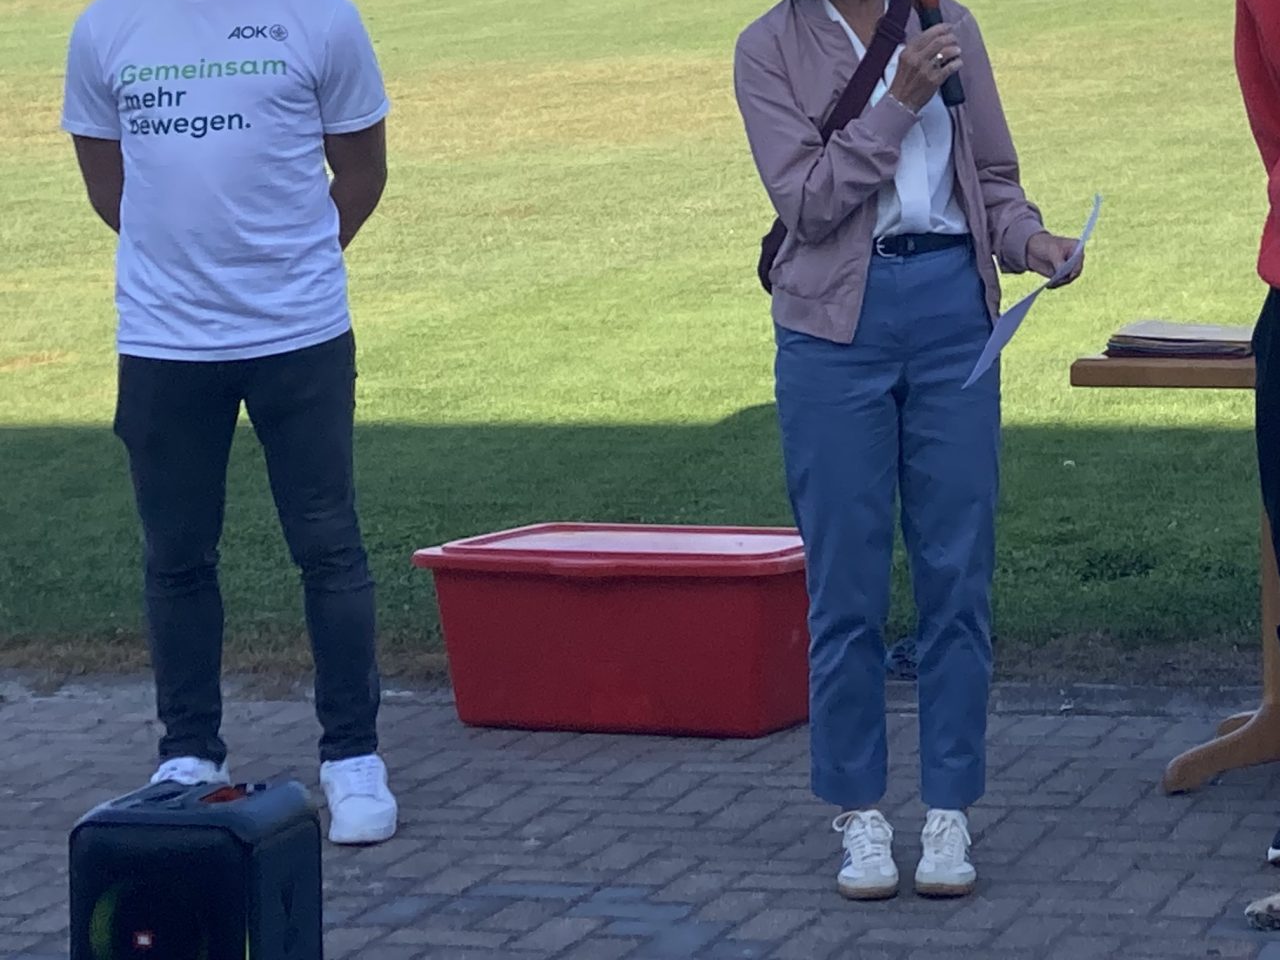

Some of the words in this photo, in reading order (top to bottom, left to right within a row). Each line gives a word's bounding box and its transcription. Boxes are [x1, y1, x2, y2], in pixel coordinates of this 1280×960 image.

[228, 25, 268, 39] AOK
[120, 59, 288, 85] Gemeinsam
[124, 86, 187, 110] mehr
[129, 113, 251, 138] bewegen.
